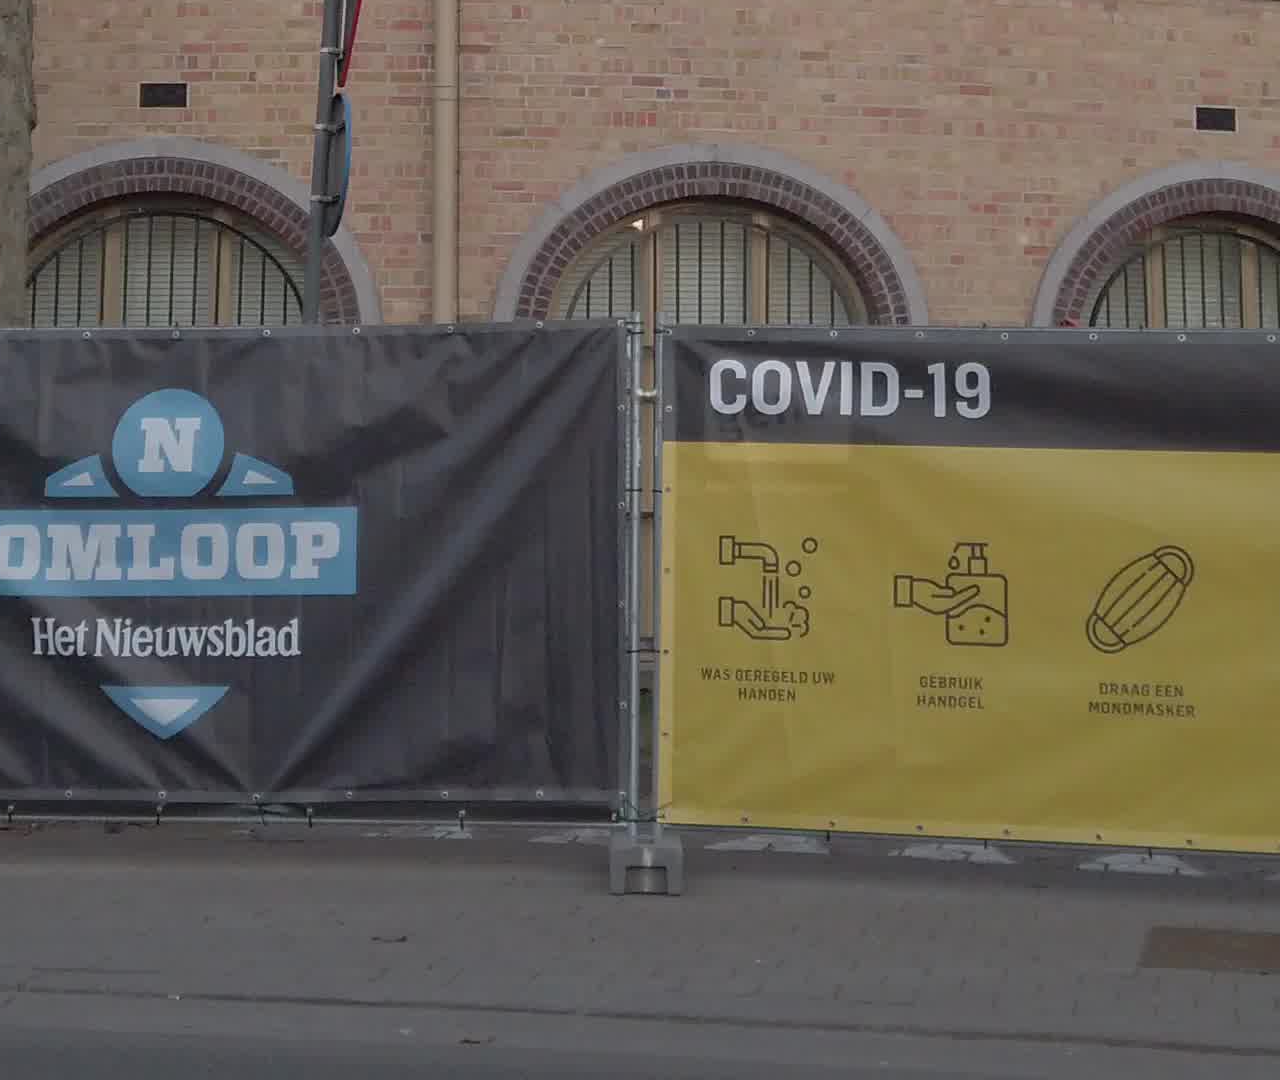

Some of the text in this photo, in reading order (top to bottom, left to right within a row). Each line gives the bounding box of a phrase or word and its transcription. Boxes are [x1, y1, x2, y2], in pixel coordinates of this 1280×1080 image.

[709, 359, 991, 419] COVID-19
[137, 417, 201, 473] N
[30, 616, 302, 658] Het Nieuwsblad
[700, 667, 835, 687] WAS GEREGELD UW
[919, 675, 985, 692] GEBRUIK
[737, 686, 797, 703] HANDEN
[1098, 682, 1185, 699] DRAAG EEN
[916, 693, 985, 710] HANDGEL
[1087, 700, 1196, 719] MONDMASKER
